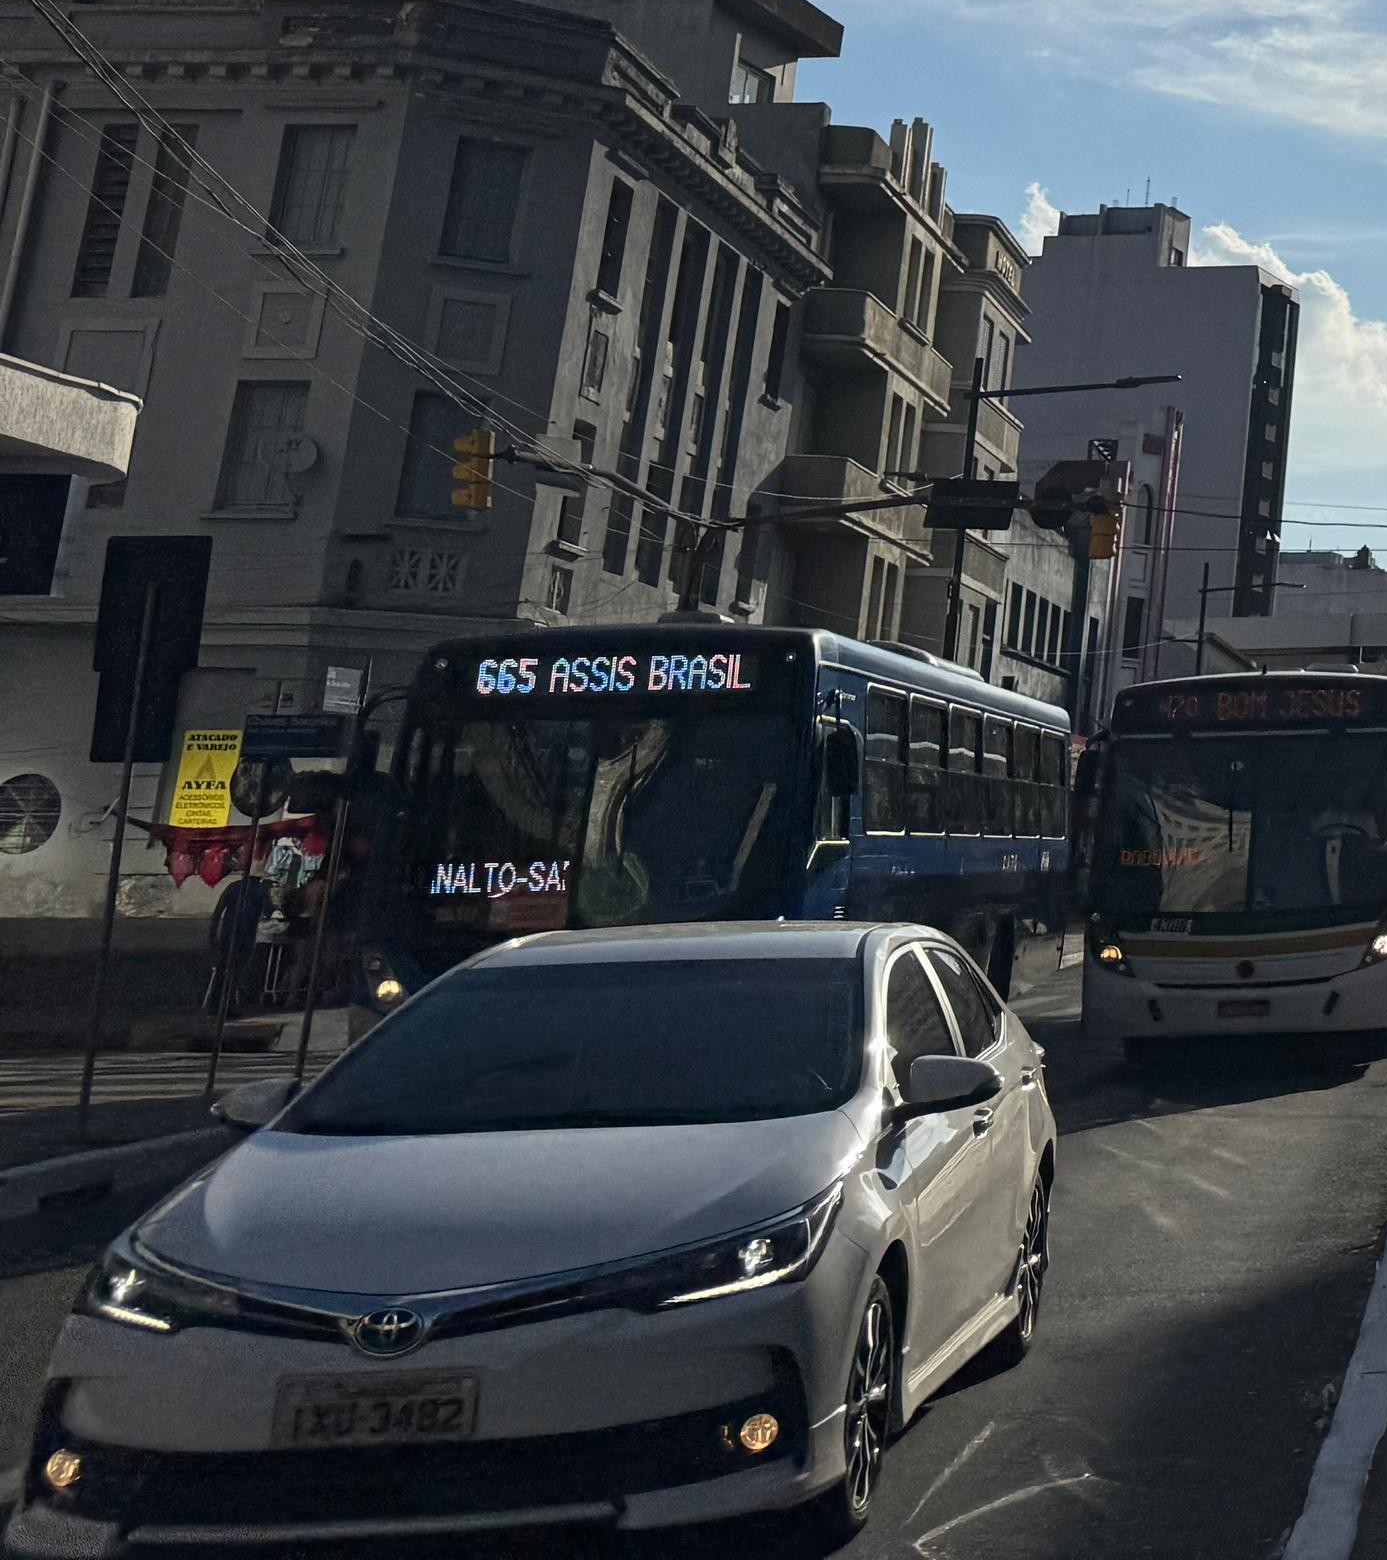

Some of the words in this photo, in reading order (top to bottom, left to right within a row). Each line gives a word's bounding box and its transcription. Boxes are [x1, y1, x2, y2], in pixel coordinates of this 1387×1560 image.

[477, 658, 538, 694] 665
[549, 656, 637, 692] ASSIS
[648, 654, 751, 690] BRASIL
[1216, 690, 1268, 721] BOM
[1279, 688, 1361, 719] JESUS
[189, 734, 238, 742] ATACADO
[197, 743, 237, 751] VAREJO
[182, 780, 227, 790] AYFA
